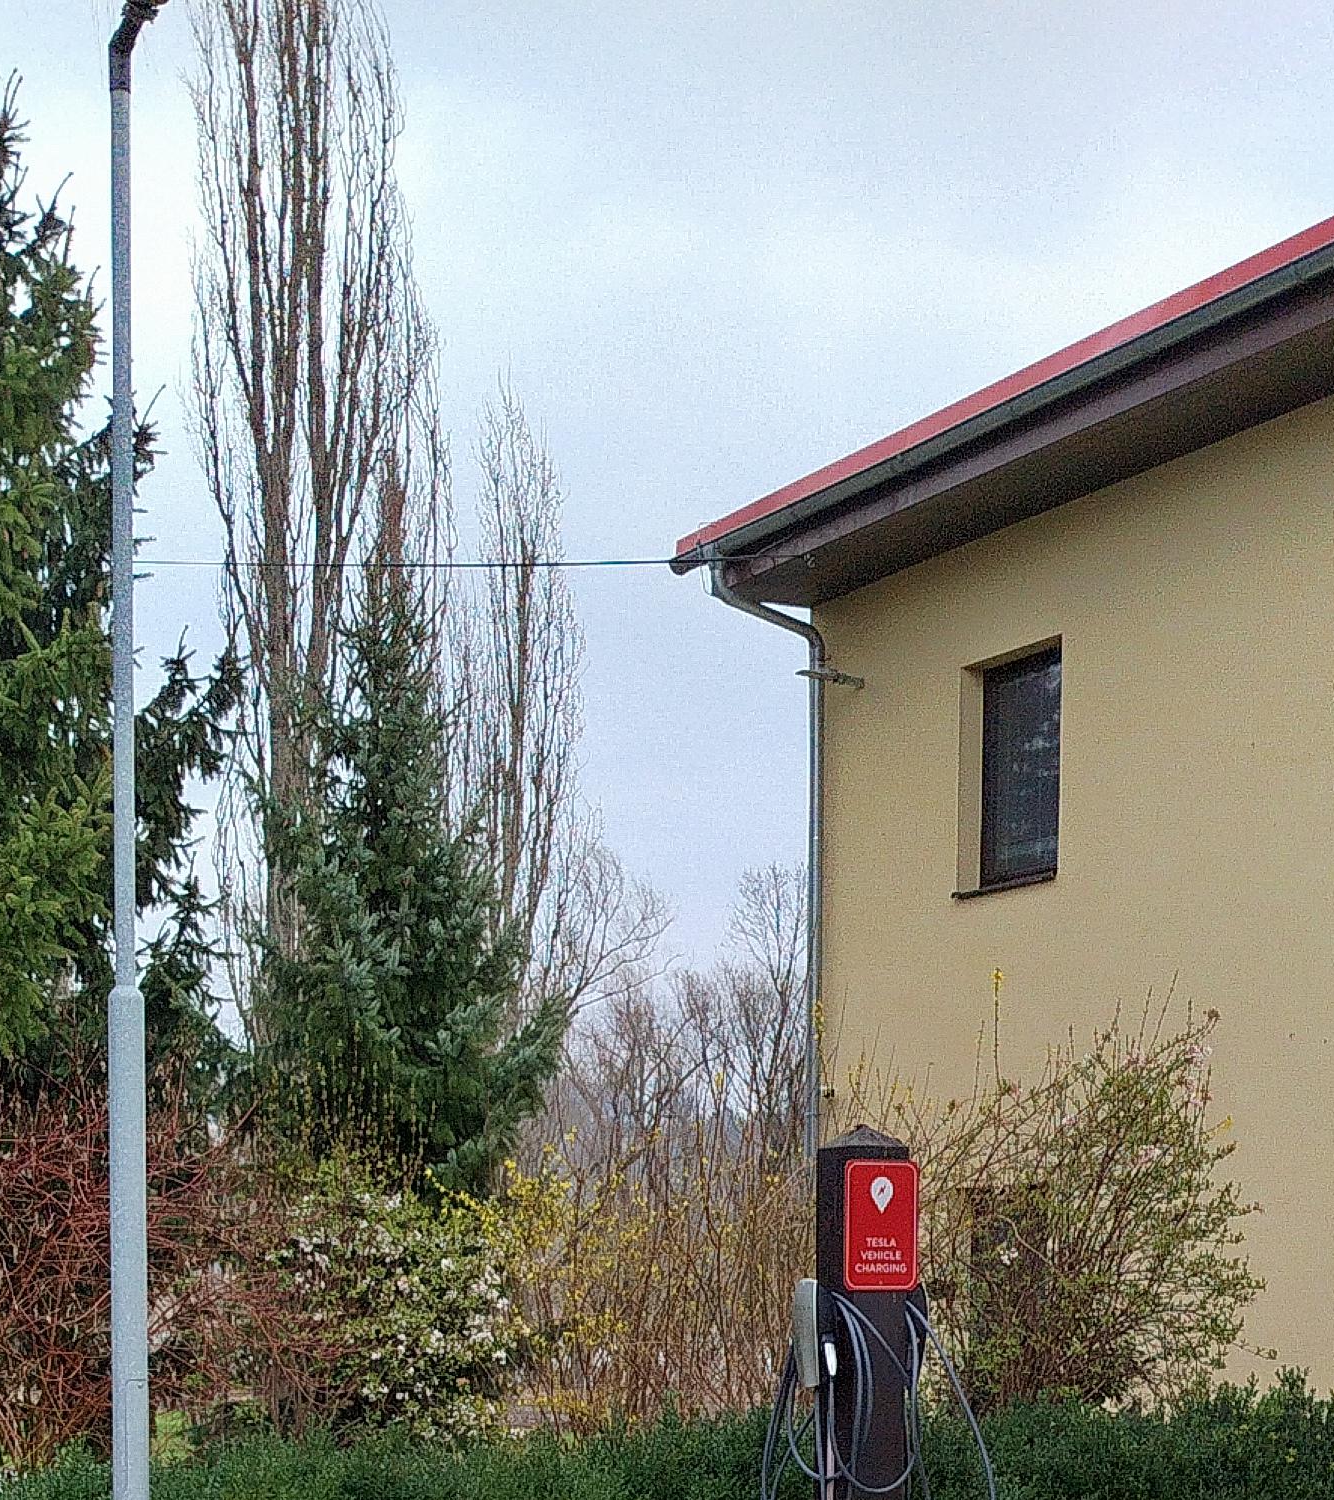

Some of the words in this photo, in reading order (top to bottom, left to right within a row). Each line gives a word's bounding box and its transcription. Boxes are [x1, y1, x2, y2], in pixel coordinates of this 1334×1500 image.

[866, 1237, 897, 1247] TESLA
[860, 1250, 902, 1260] VEHICLE
[855, 1263, 907, 1273] CHARGING
